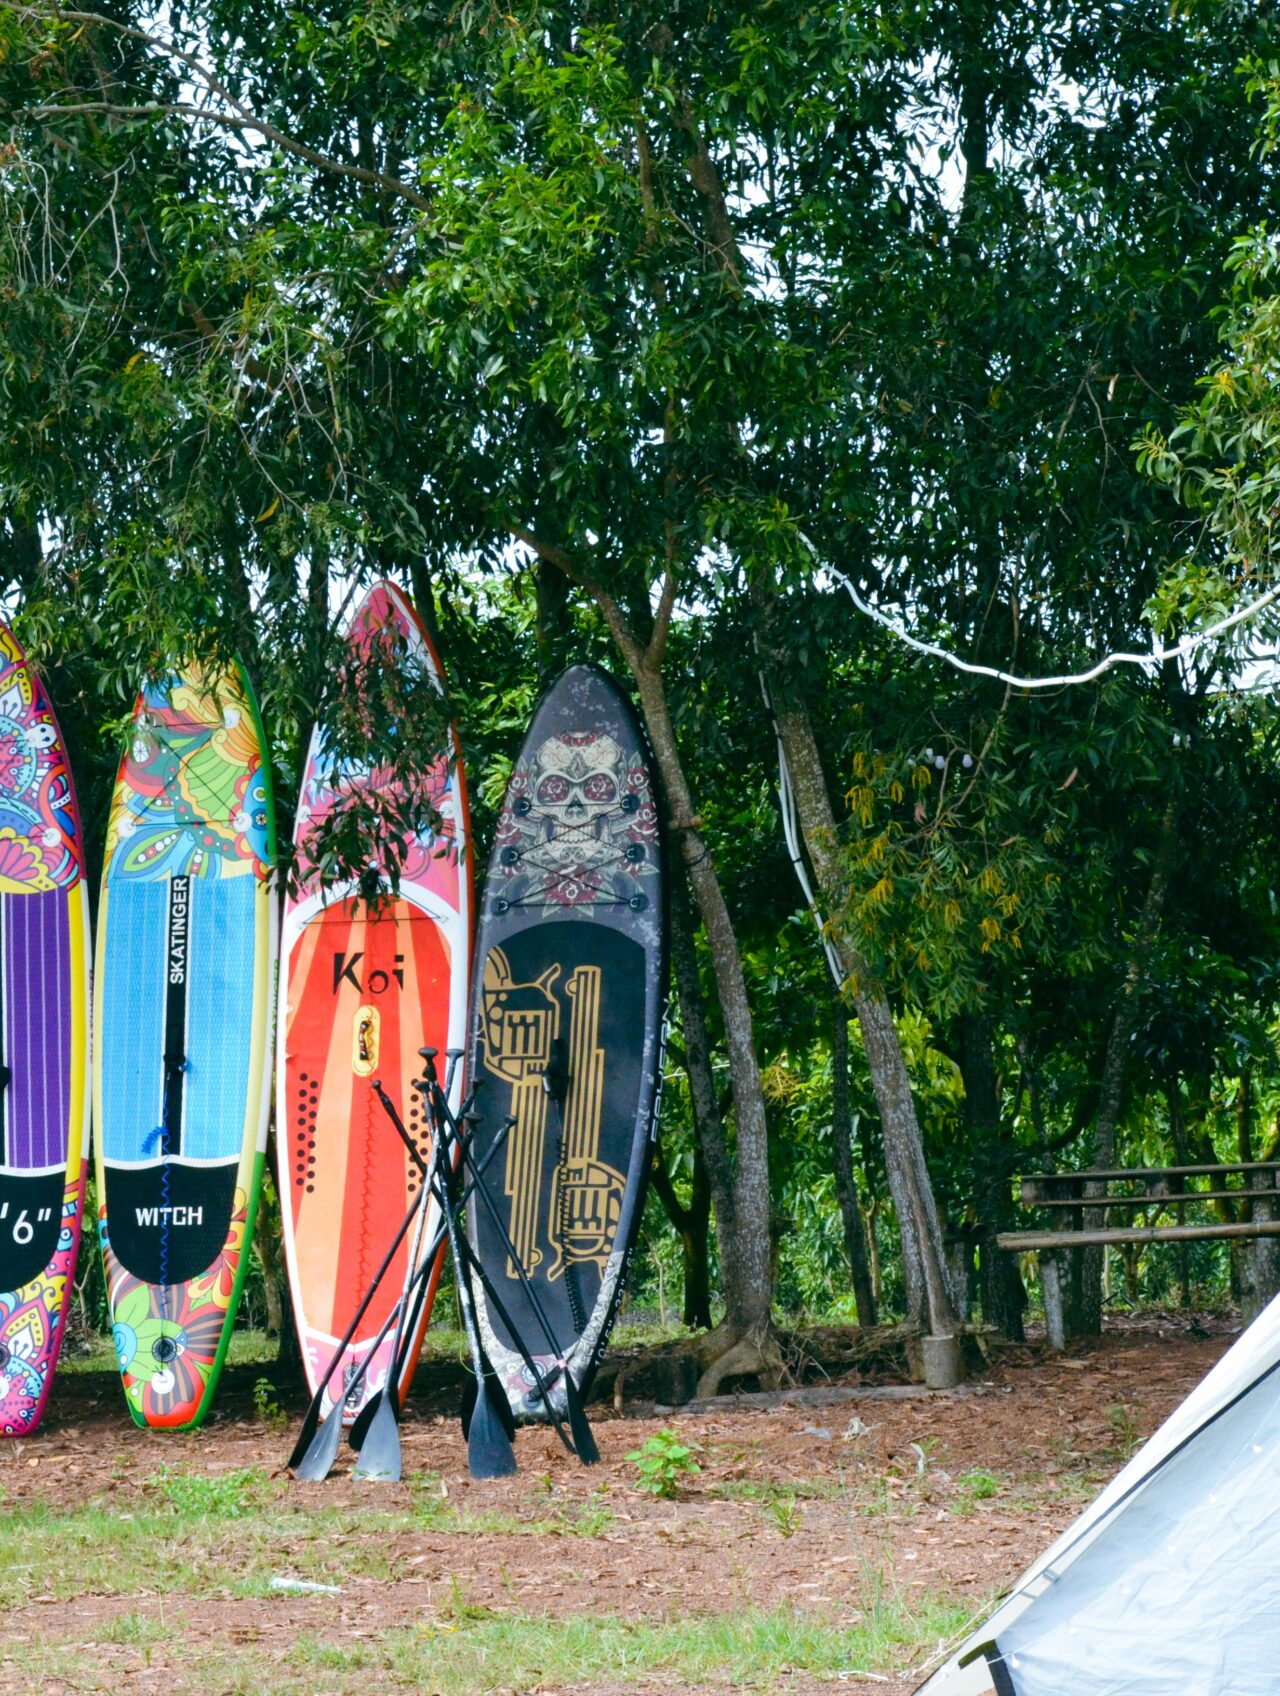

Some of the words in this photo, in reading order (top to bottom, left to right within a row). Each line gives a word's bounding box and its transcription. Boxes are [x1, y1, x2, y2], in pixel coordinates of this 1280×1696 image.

[170, 878, 188, 984] SKATINGER
[333, 952, 404, 995] Koi
[135, 1206, 203, 1227] WITCH
